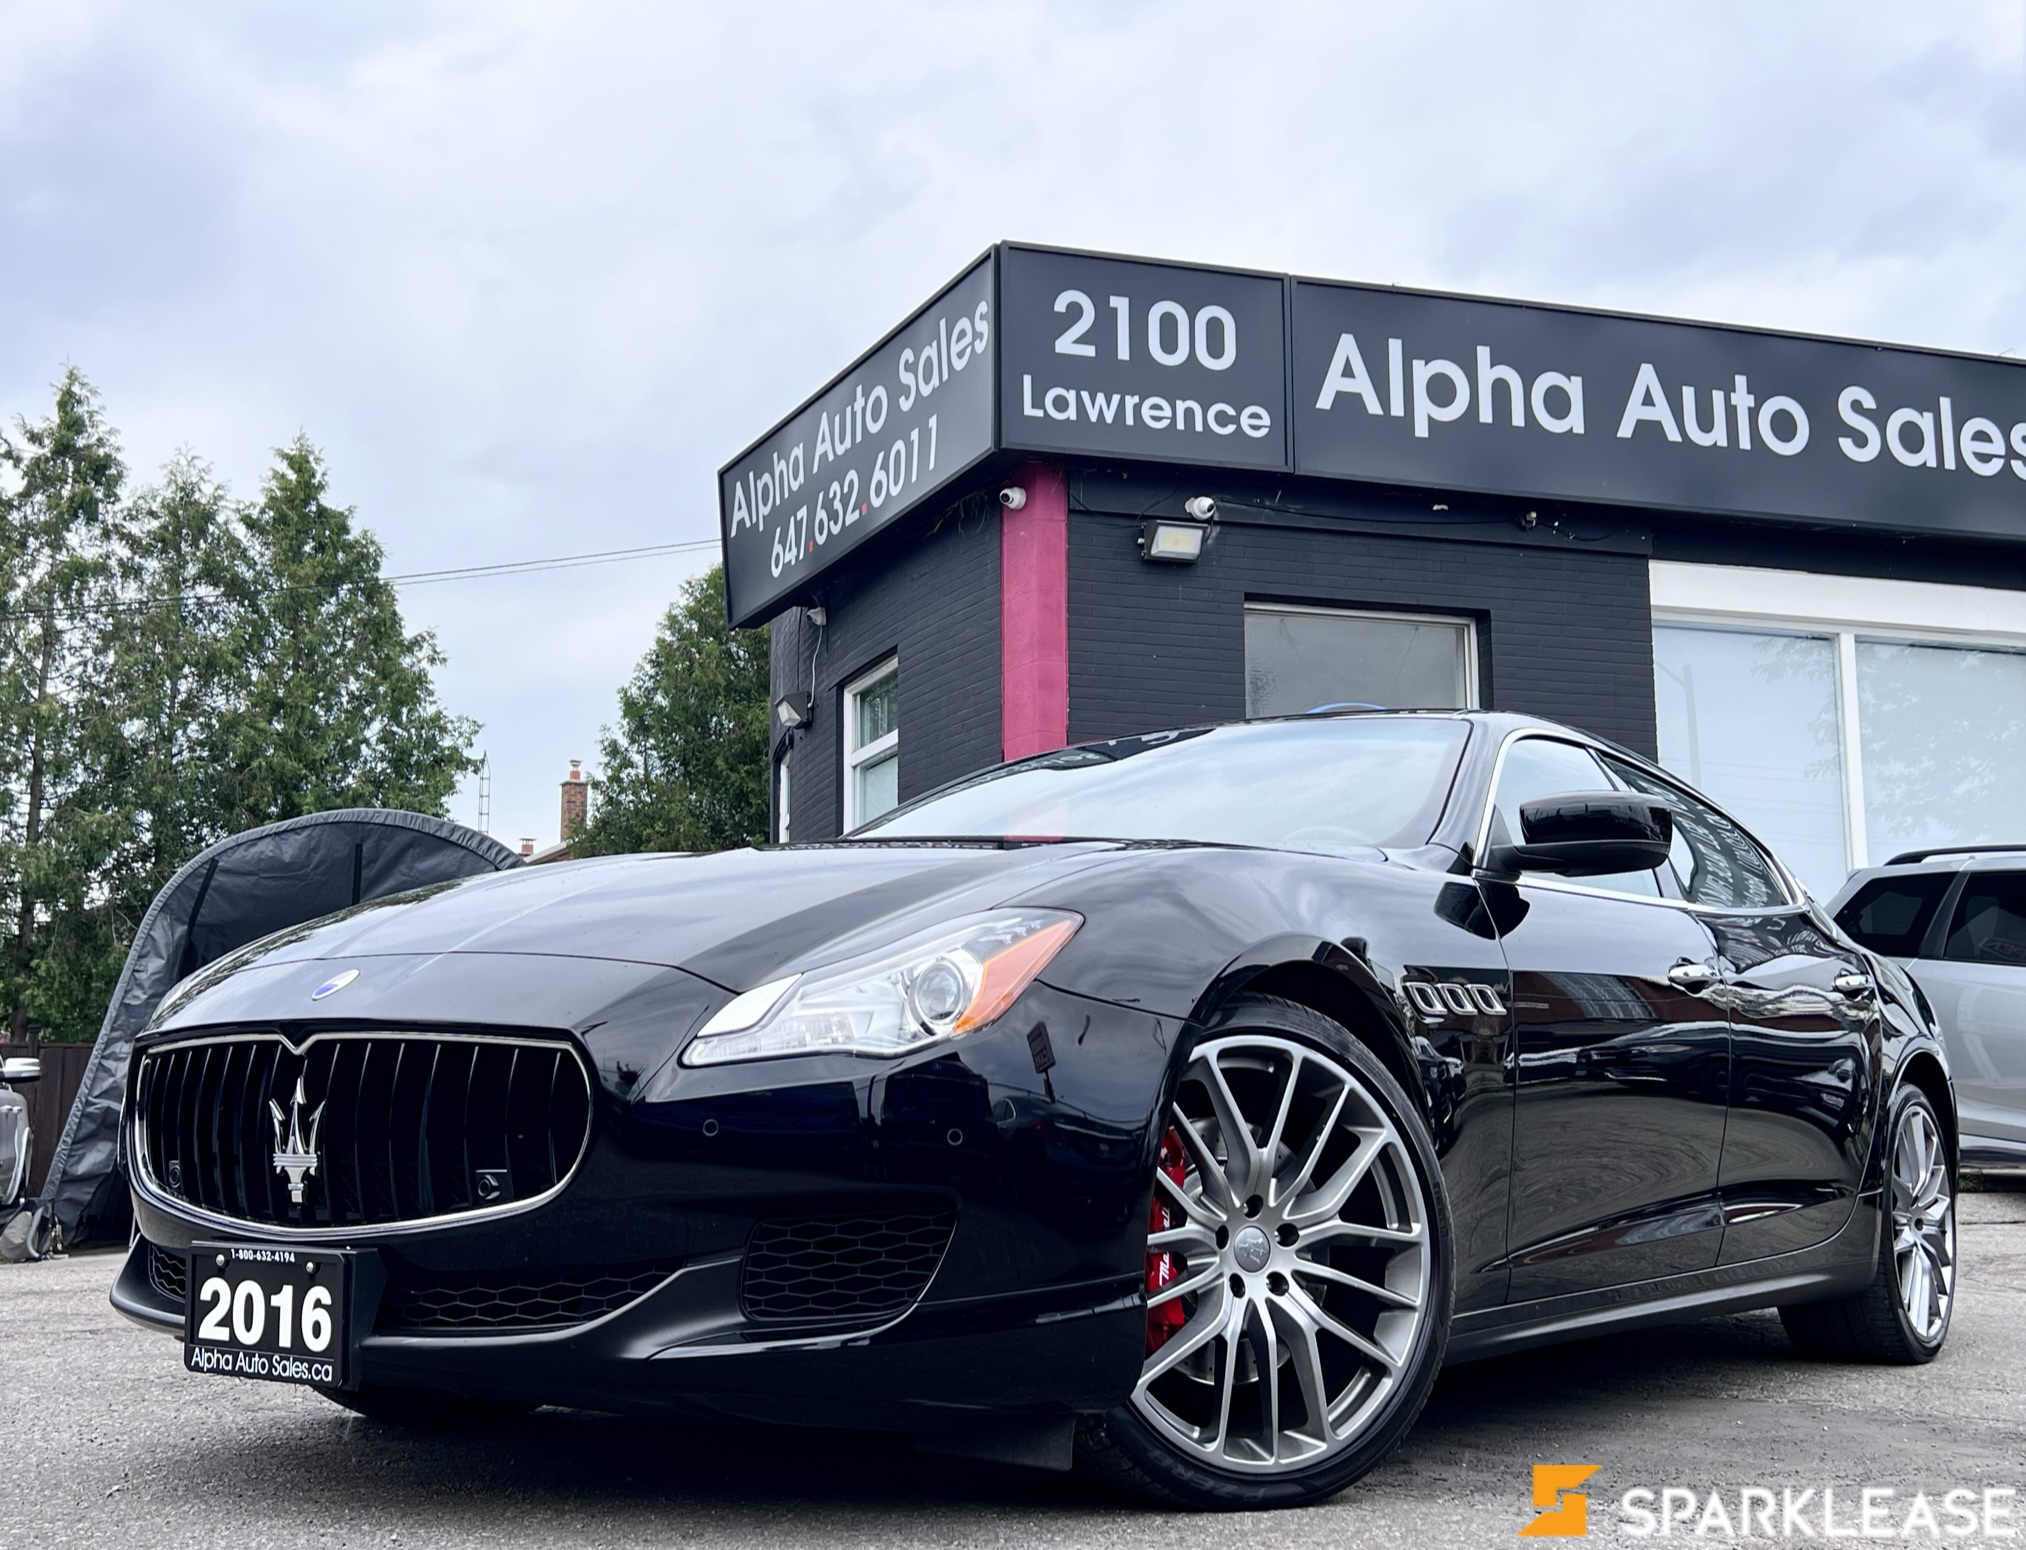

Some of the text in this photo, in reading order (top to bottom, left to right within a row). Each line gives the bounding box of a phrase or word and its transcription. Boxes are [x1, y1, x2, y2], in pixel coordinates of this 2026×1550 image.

[1053, 290, 1236, 371] 2100
[730, 299, 989, 538] Alpha Auto Sales
[1023, 374, 1272, 438] Lawrence
[1315, 333, 1586, 438] Alpha
[1616, 363, 1811, 456] Auto
[769, 415, 938, 579] 647.632.6011
[231, 1249, 295, 1262] 1-800-632-4194
[198, 1277, 332, 1352] 2016
[191, 1347, 333, 1382] Alpha Auto Sales.ca
